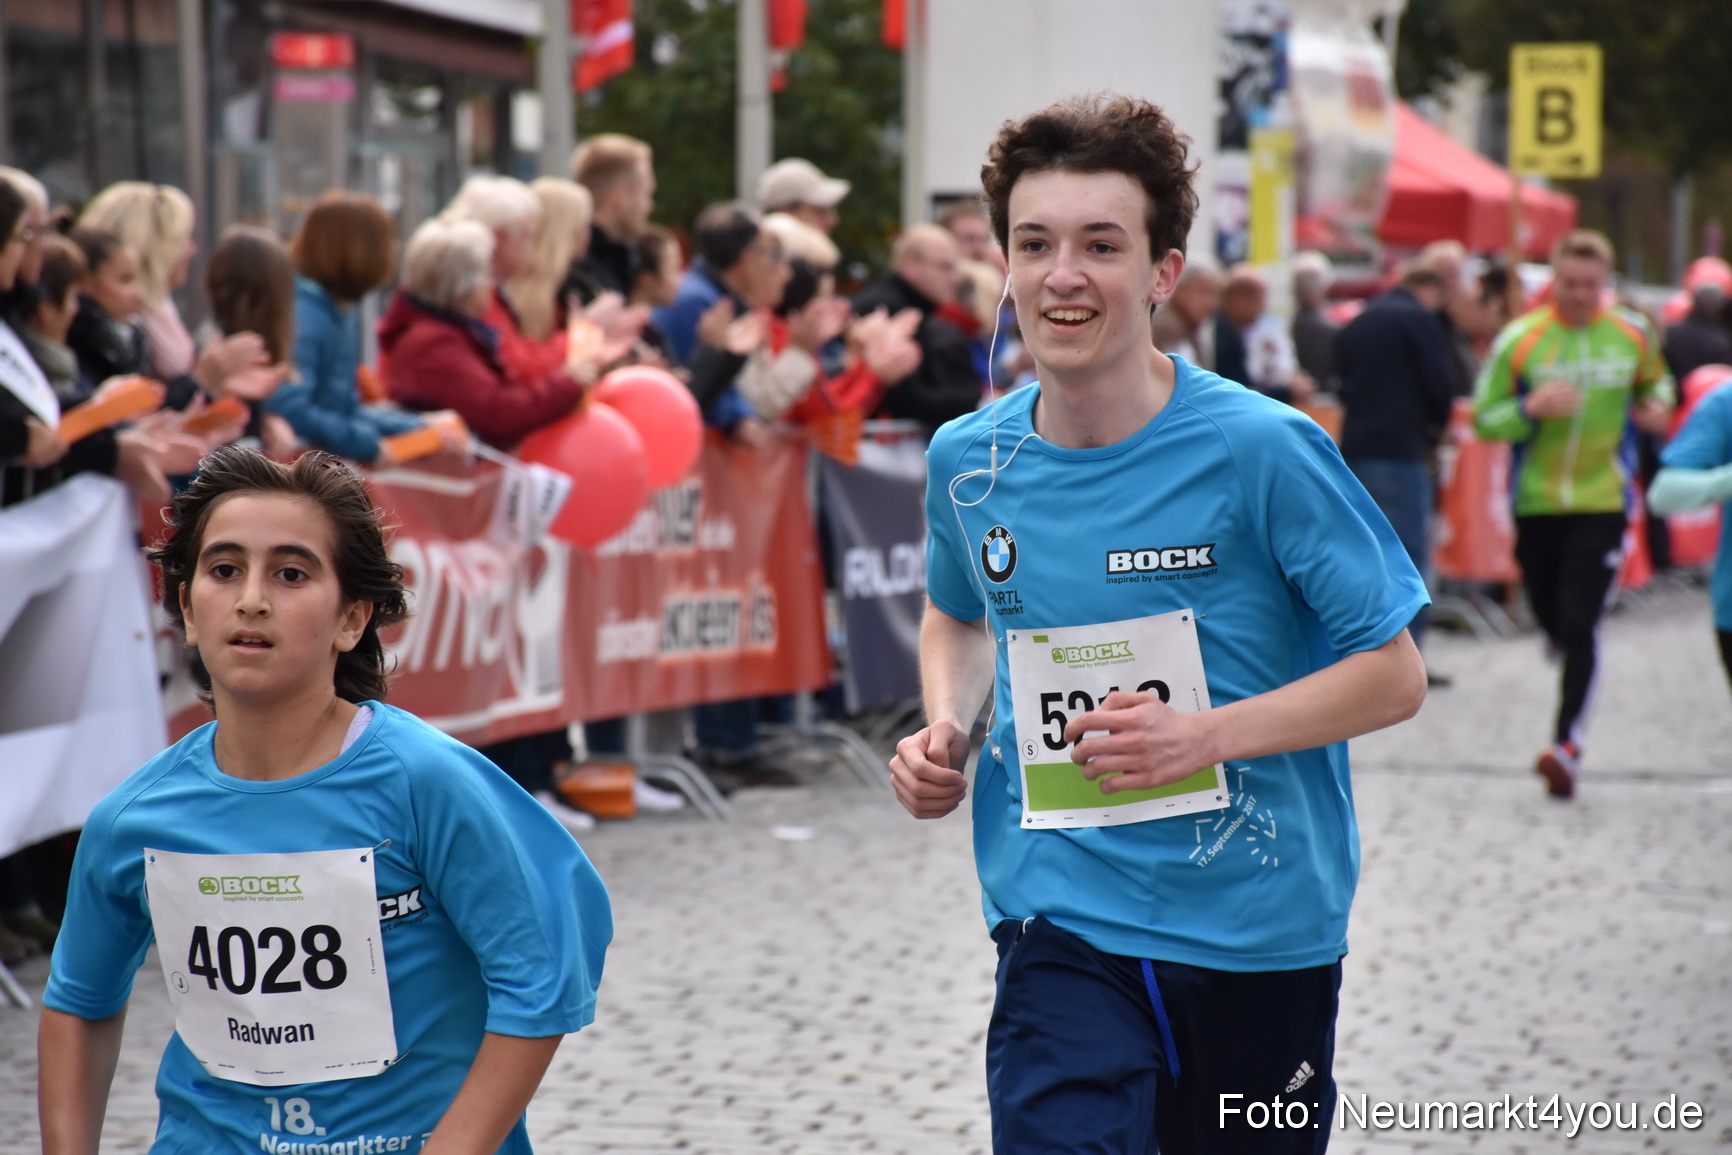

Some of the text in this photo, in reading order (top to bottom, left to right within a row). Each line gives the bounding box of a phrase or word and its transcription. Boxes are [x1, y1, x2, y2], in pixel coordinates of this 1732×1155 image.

[1536, 87, 1577, 146] B
[1107, 544, 1215, 574] BOCK
[1106, 568, 1218, 585] inspired by smart concepts
[1066, 640, 1133, 663] BOCK
[1110, 656, 1136, 665] concepts
[1027, 745, 1034, 755] S
[1197, 795, 1257, 868] 17. September 2017
[221, 875, 302, 894] BOCK
[376, 886, 424, 922] CK
[188, 925, 347, 994] 4028
[177, 977, 184, 988] J
[228, 1017, 315, 1044] Radwan
[264, 1097, 327, 1136] 18.
